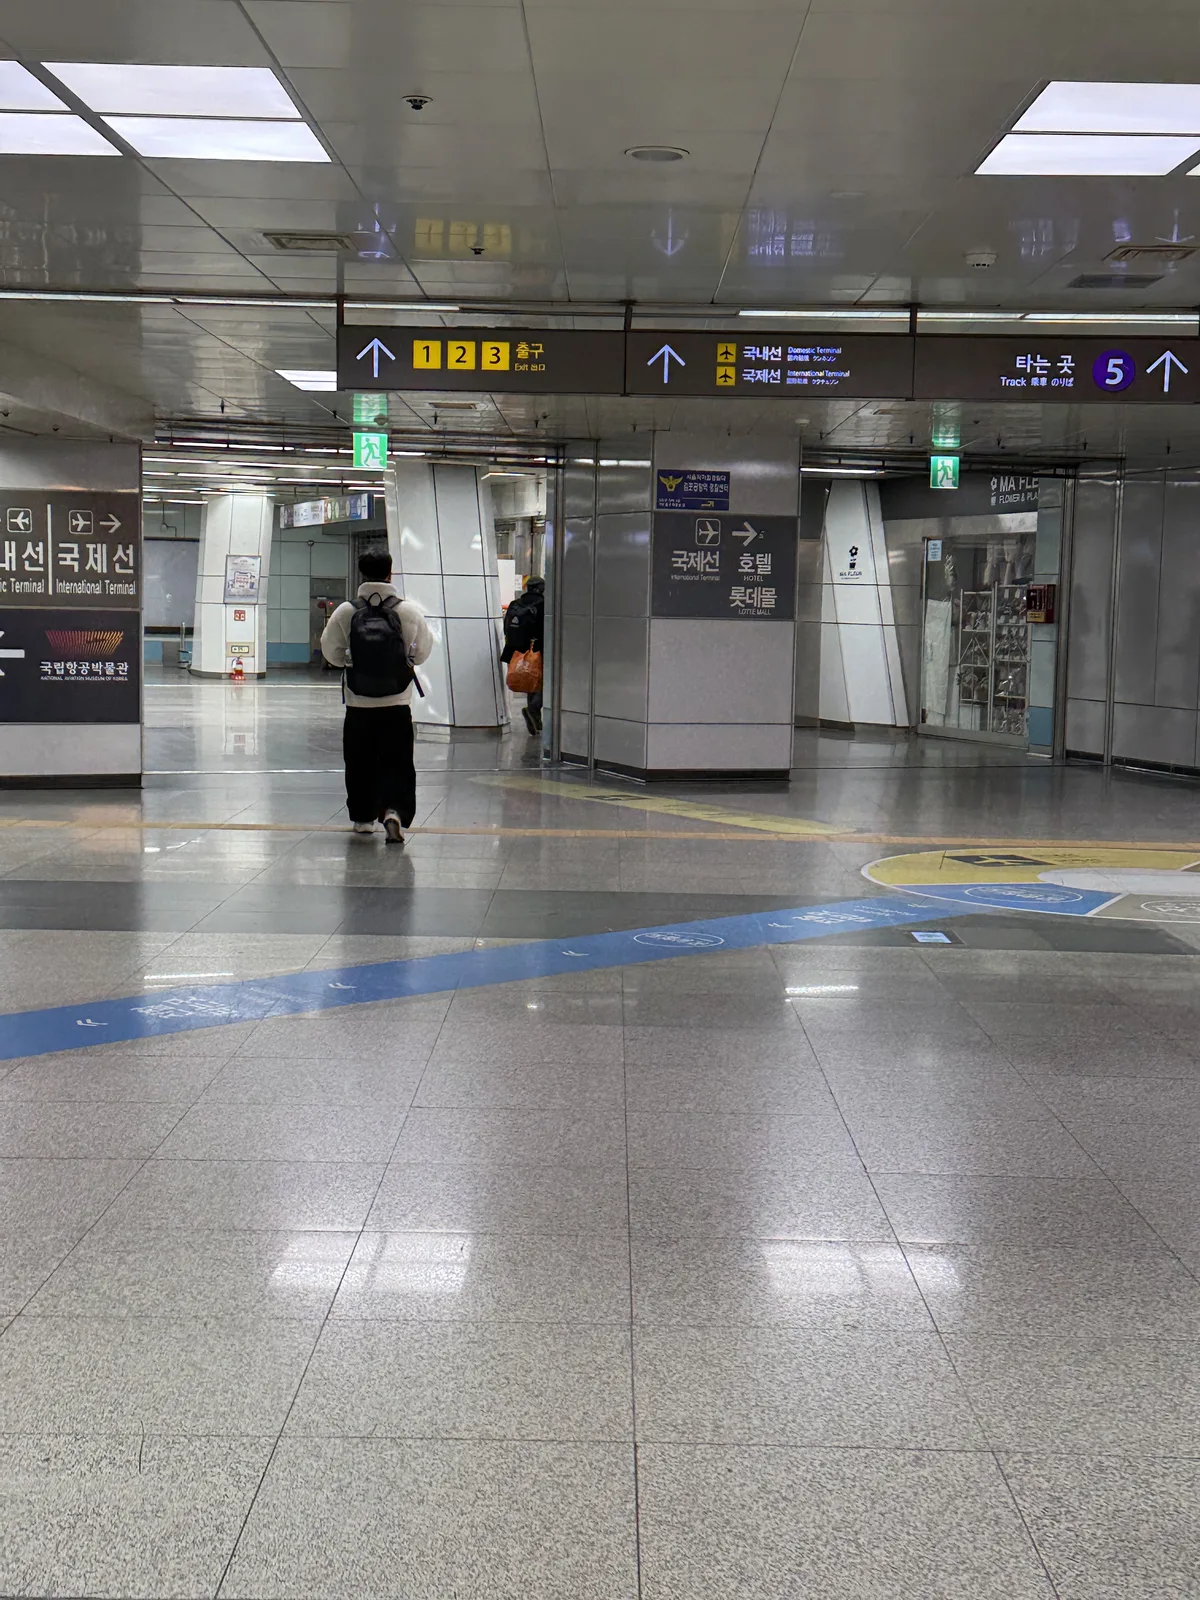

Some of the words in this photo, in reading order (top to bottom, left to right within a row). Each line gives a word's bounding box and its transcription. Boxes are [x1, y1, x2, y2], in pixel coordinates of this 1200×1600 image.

[422, 345, 430, 363] 1
[455, 346, 467, 364] 2
[489, 346, 501, 364] 3
[515, 341, 545, 360] 출구
[742, 346, 782, 361] 국내선
[787, 346, 815, 355] Domestic
[816, 347, 842, 355] Terminal
[514, 363, 529, 372] Exit
[1015, 354, 1052, 374] 타는
[1056, 354, 1076, 374] 곳
[1105, 358, 1124, 385] 5
[742, 368, 781, 384] 국제선
[787, 369, 825, 378] International
[825, 370, 851, 378] Terminal
[1000, 376, 1027, 387] Track
[1051, 377, 1074, 387] のりば
[999, 476, 1016, 492] MA
[58, 543, 134, 574] 국제선
[671, 550, 720, 572] 국제선
[738, 553, 772, 575] 호텔
[10, 578, 45, 593] Terminal
[56, 579, 102, 594] International
[104, 580, 137, 595] Terminal
[729, 586, 778, 608] 롯데몰
[40, 661, 129, 675] 국립항공박물관
